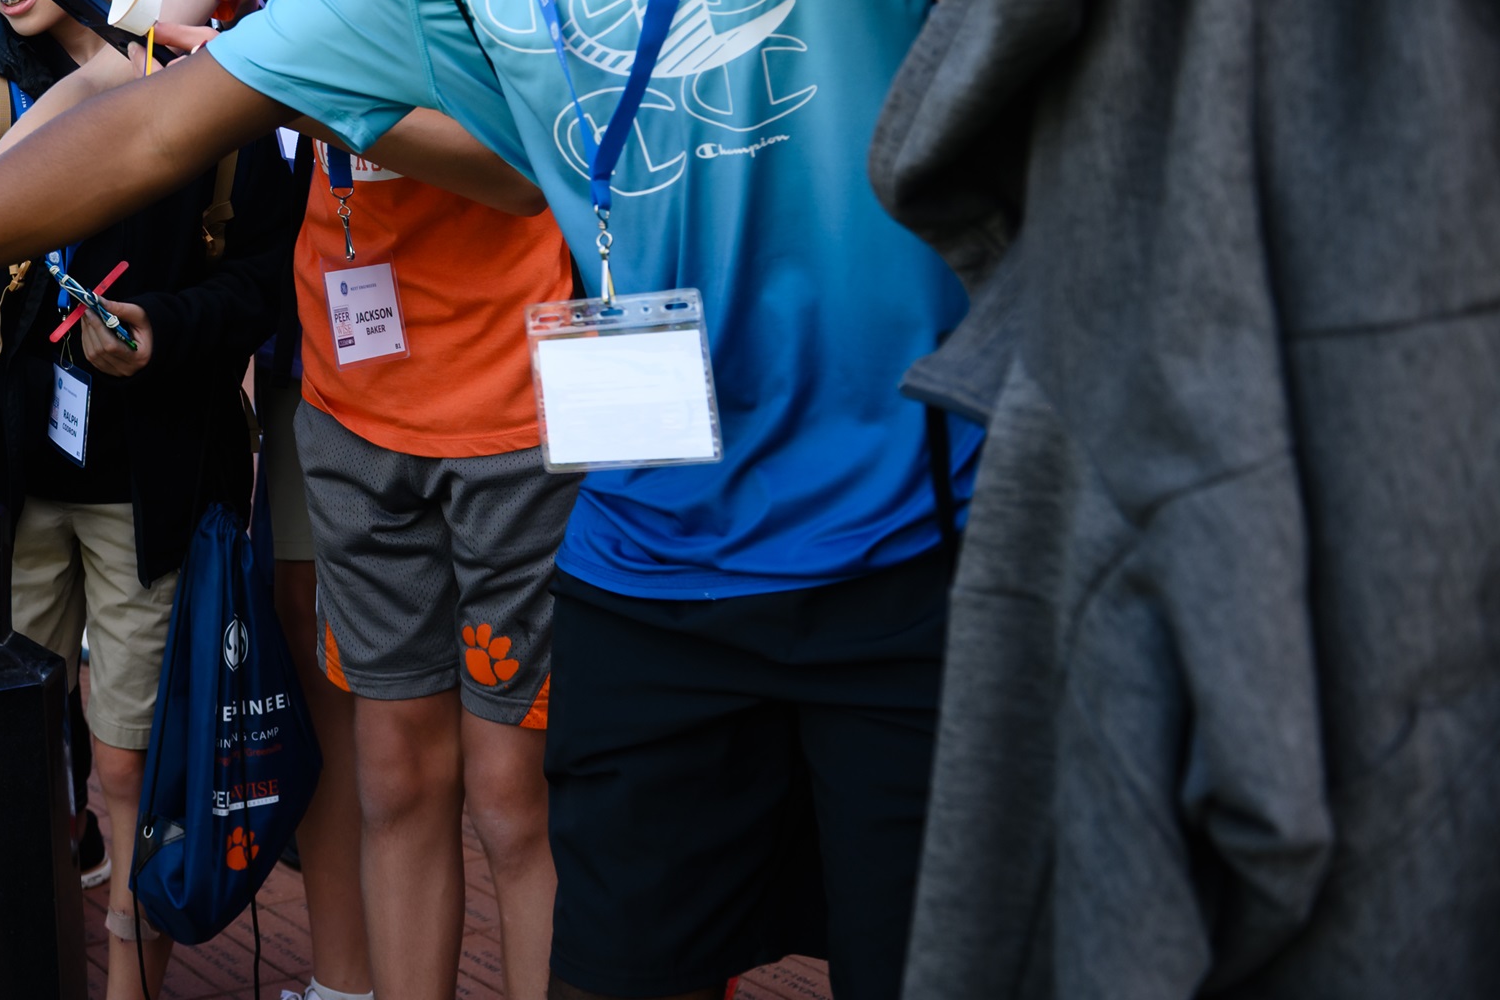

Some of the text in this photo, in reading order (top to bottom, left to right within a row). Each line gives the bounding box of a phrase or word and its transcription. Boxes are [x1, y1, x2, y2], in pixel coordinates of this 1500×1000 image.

[695, 134, 791, 159] Champion
[334, 311, 351, 324] PEER
[355, 306, 394, 324] JACKSON
[366, 324, 386, 336] BAKER
[63, 409, 78, 427] RALPH
[251, 726, 279, 741] CAMP
